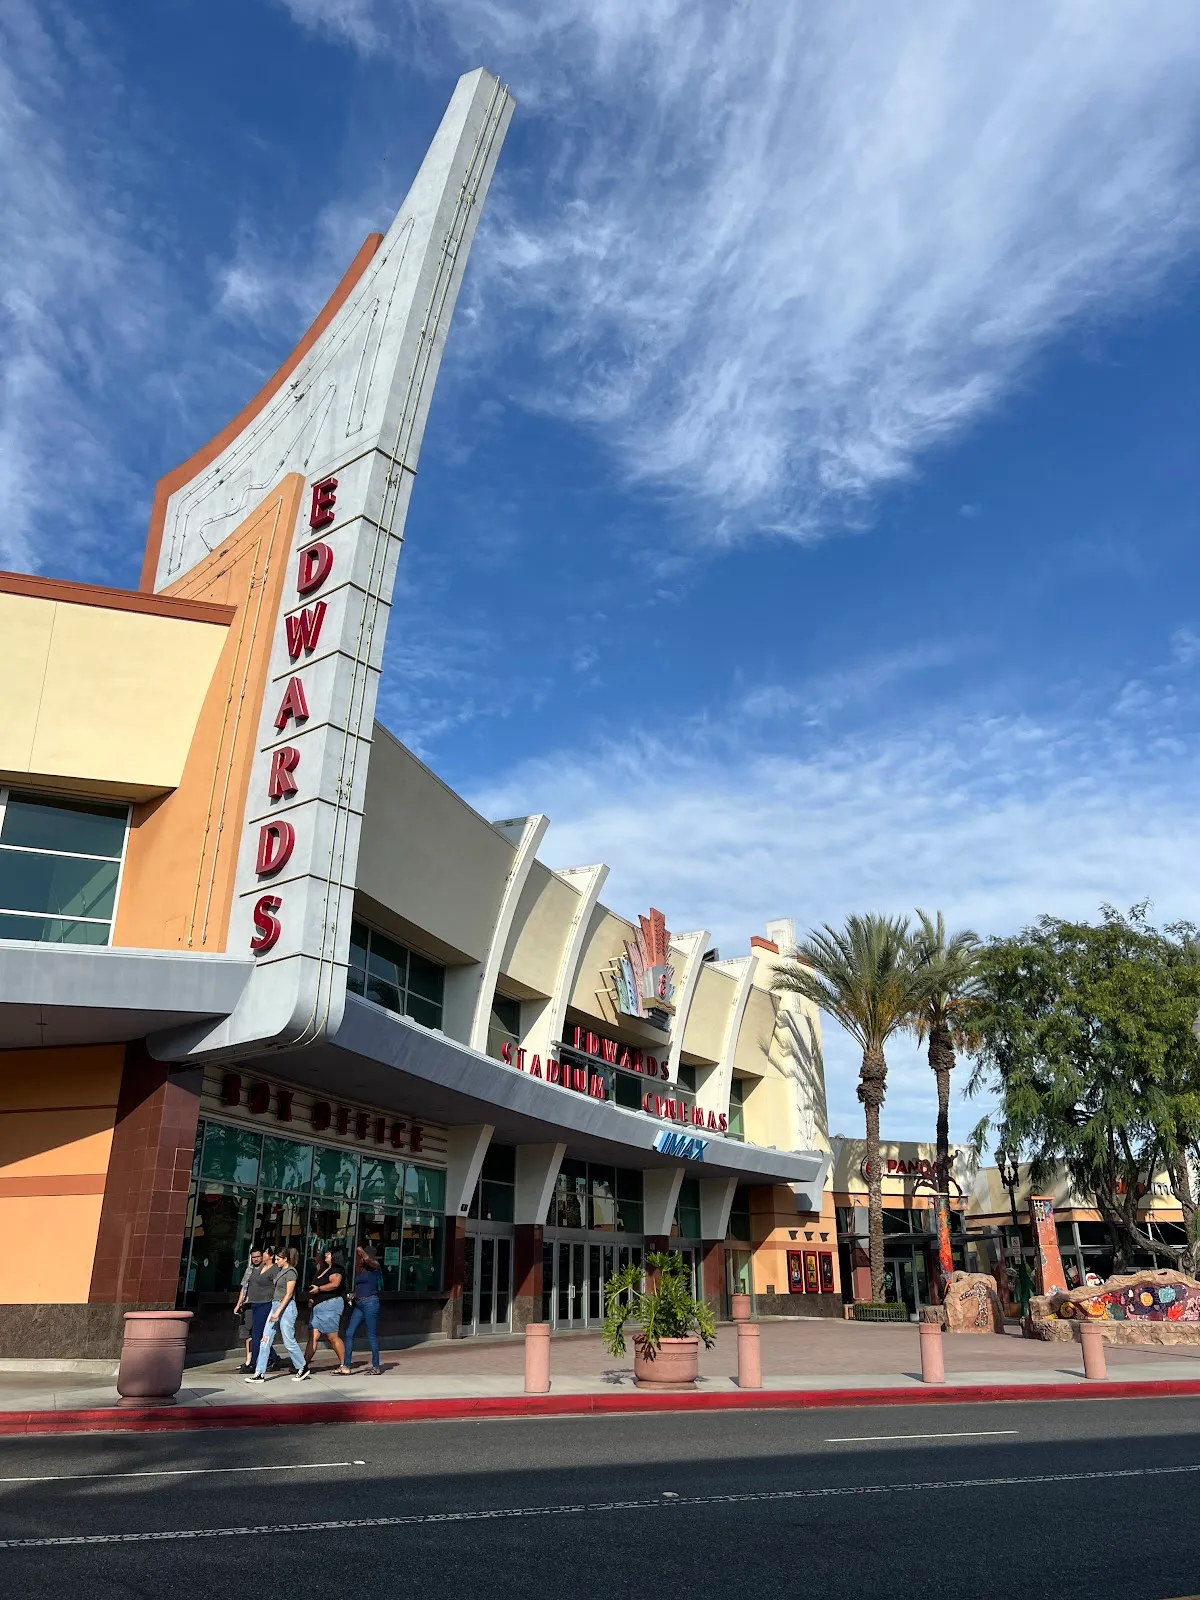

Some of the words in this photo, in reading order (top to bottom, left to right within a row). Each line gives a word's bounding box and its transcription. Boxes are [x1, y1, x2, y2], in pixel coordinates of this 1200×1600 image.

[250, 477, 338, 952] EDWARDS
[501, 1041, 606, 1100] STADIUM
[642, 1091, 728, 1132] CINEMAS
[573, 1026, 670, 1081] EDWARDS
[221, 1073, 294, 1122] BOX
[312, 1101, 425, 1153] OFFICE
[654, 1129, 709, 1161] IMAX
